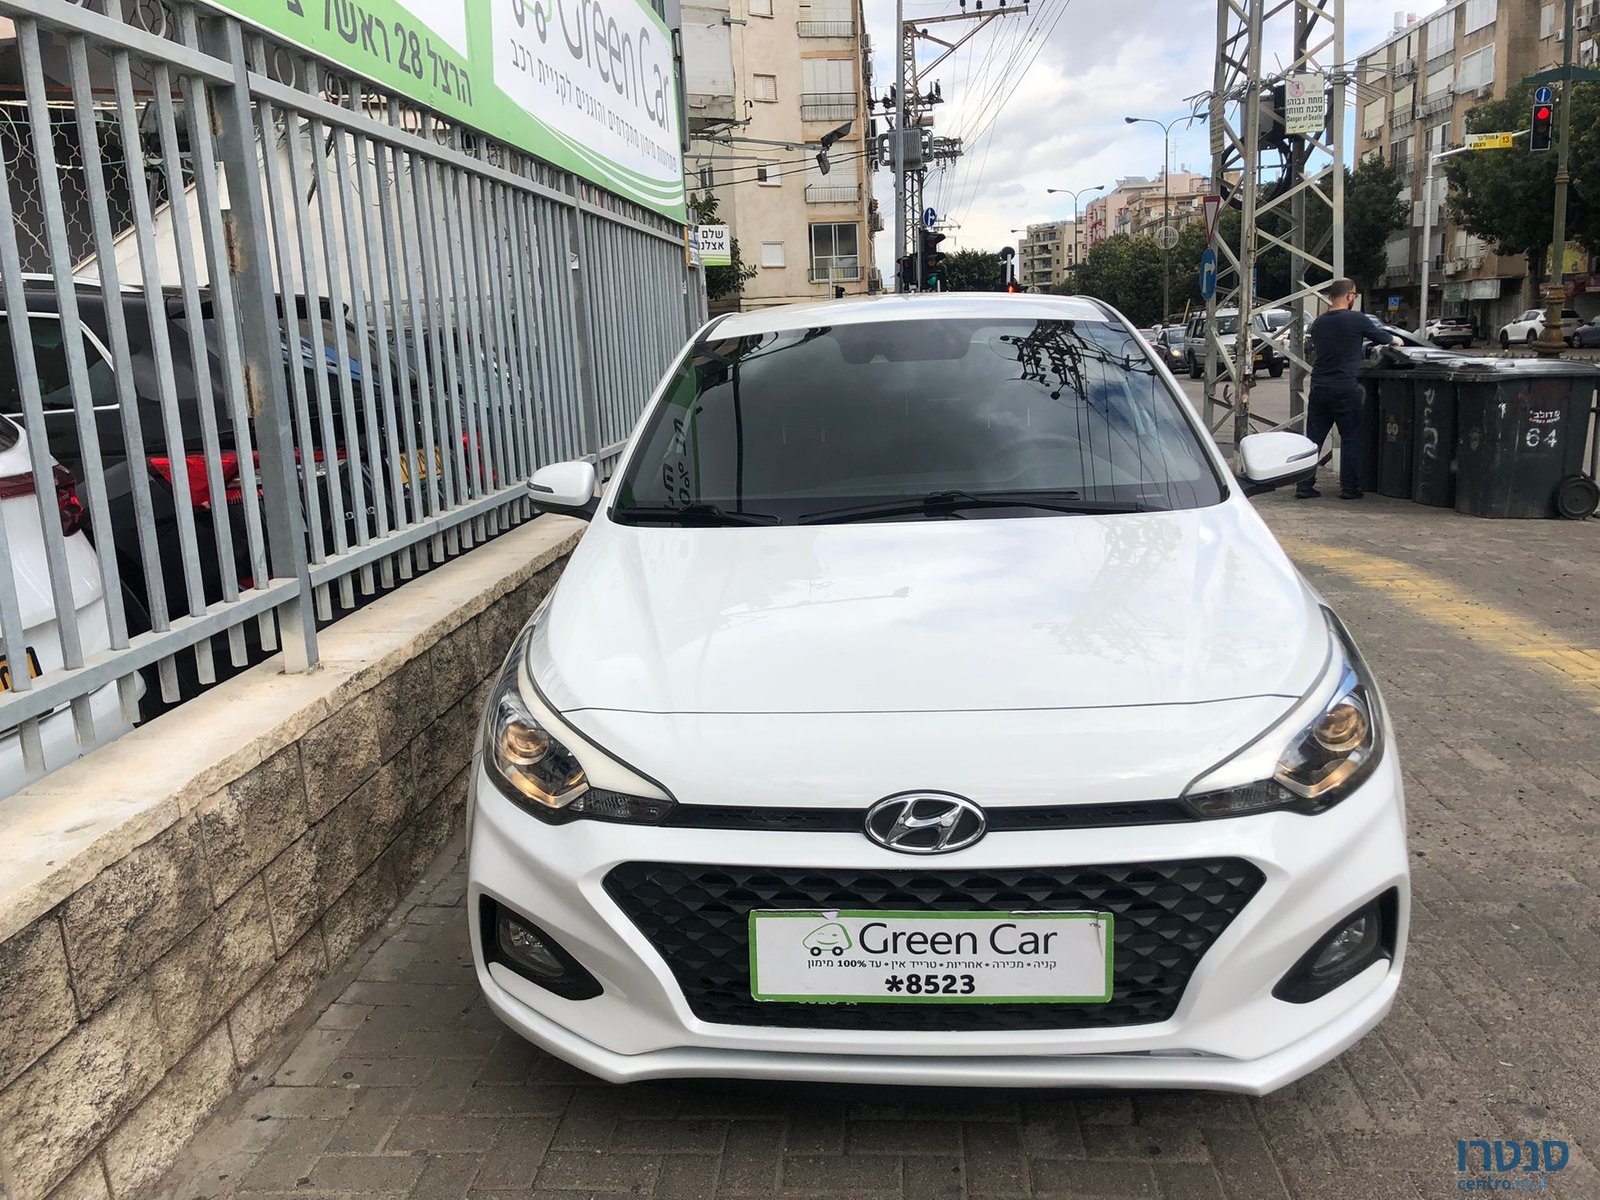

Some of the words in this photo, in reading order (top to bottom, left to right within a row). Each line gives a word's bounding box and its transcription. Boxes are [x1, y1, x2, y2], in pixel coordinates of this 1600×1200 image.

[394, 22, 424, 80] 28
[510, 38, 534, 78] רכב
[425, 37, 473, 107] הרצל
[537, 57, 572, 106] לקניית
[639, 26, 670, 133] Car
[1308, 96, 1323, 104] מתח
[701, 228, 724, 239] שלם
[1526, 427, 1557, 447] 64
[859, 922, 977, 955] Green
[989, 923, 1058, 955] Car
[807, 959, 834, 969] מימון
[838, 960, 867, 968] 100%
[891, 960, 906, 970] אין
[909, 961, 937, 969] טרייד
[946, 961, 983, 969] אחריות
[992, 961, 1024, 969] מכירה
[1033, 960, 1057, 970] קניה
